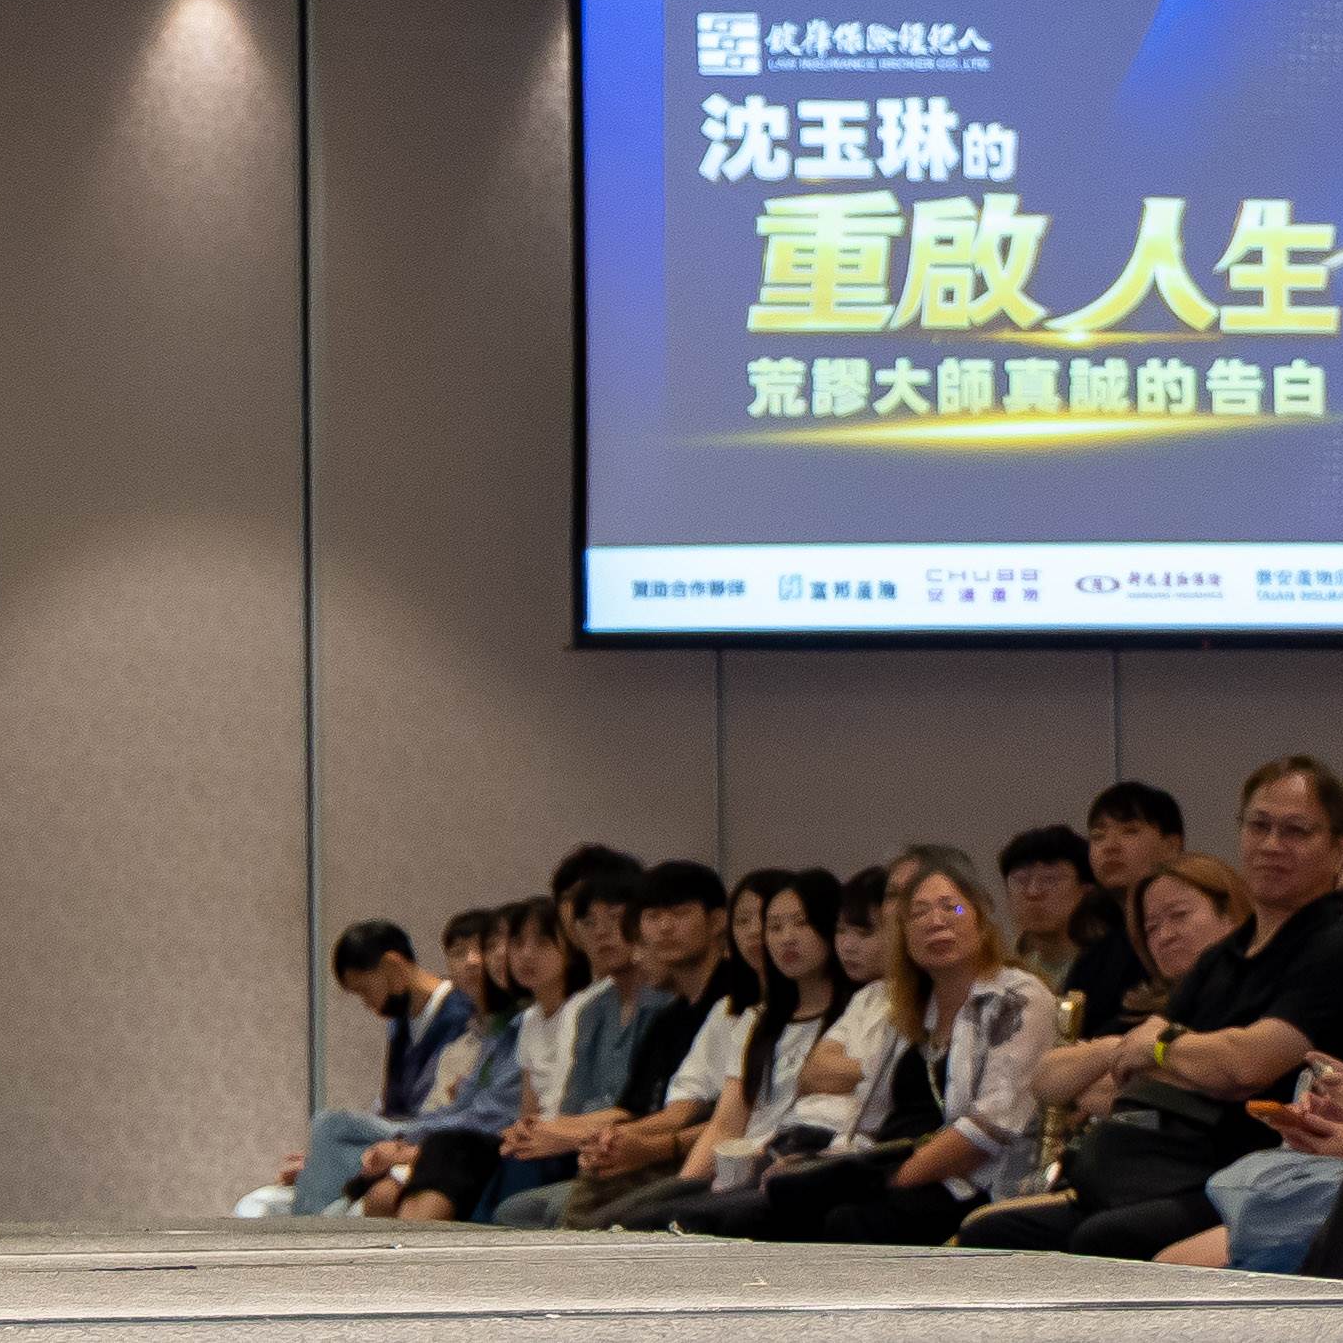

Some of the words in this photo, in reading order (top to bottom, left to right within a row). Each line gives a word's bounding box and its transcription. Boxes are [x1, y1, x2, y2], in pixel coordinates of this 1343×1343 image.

[699, 93, 1018, 183] 沈玉琳的
[746, 357, 1327, 418] 荒謬大師真誠的告白
